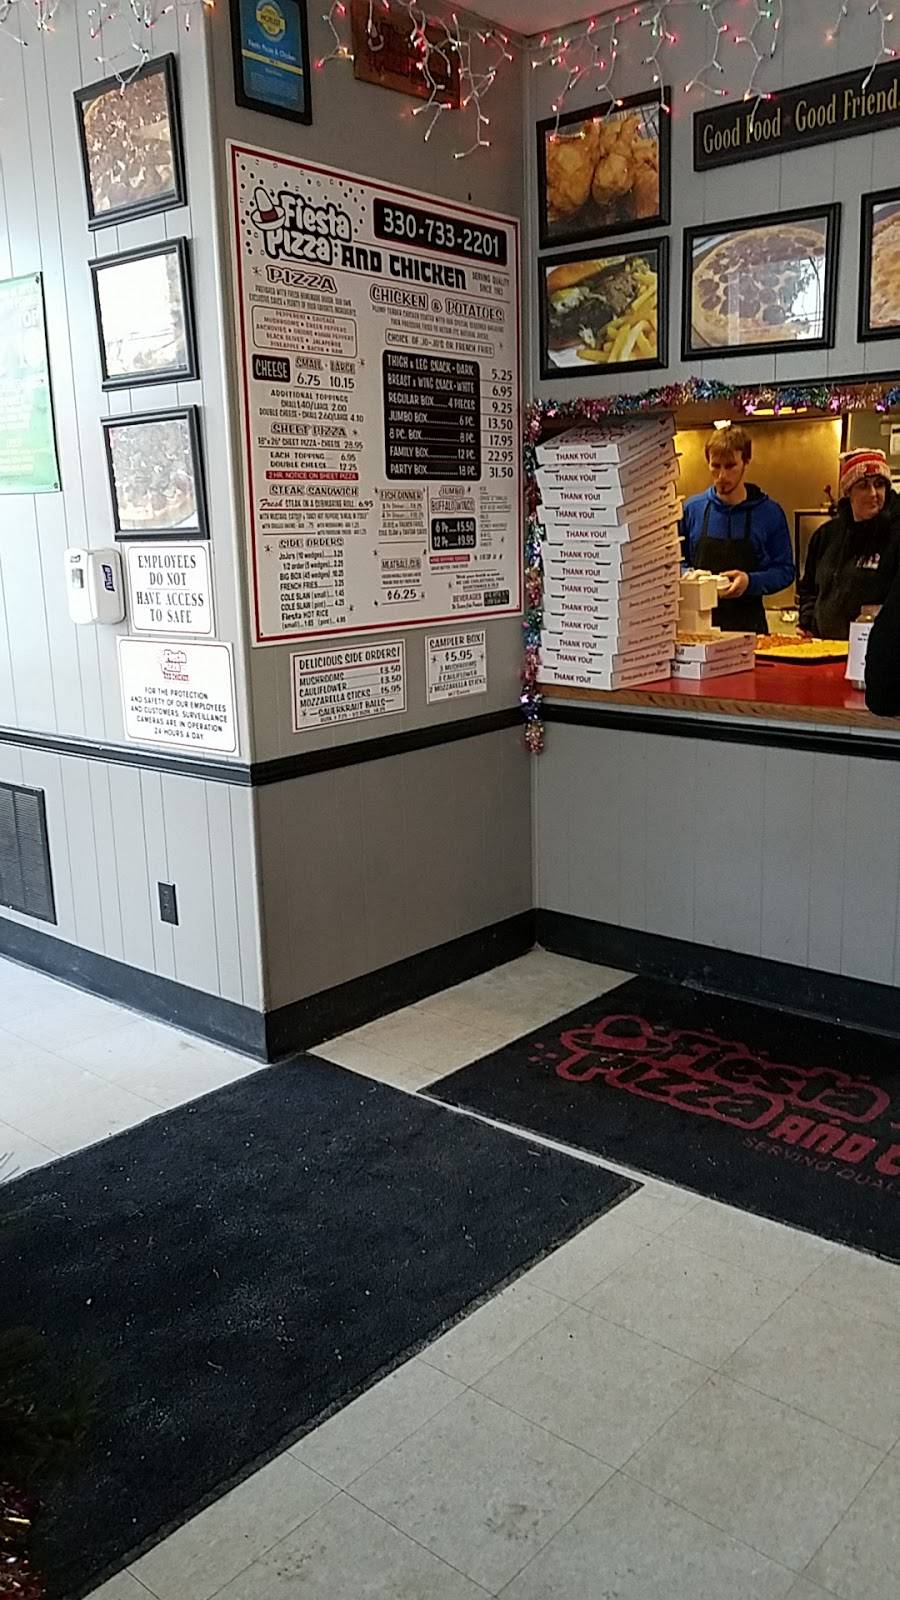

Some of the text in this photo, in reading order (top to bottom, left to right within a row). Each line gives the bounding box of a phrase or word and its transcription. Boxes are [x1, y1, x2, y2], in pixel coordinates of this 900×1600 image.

[703, 78, 900, 154] Good Food Good Friend
[278, 191, 352, 242] Fiesta
[384, 208, 499, 258] 330-733-2201
[264, 229, 466, 290] Pizza AND CHICKEN
[268, 266, 336, 293] PIZZA
[371, 285, 427, 309] CHICKEN
[447, 299, 504, 322] POTATOES
[388, 333, 492, 354] CHOICE FRENCH FRIES
[256, 359, 288, 378] CHEESE
[295, 357, 355, 374] SMALL LARGE
[387, 355, 512, 381] THIGH LEG SNACK DARK 5.25
[297, 372, 354, 388] 6.75 10.15
[388, 373, 512, 397] BREAST WING SNACK WHITE 6.95
[271, 389, 348, 402] ADDITIONAL TOPPINGS
[389, 392, 512, 414] REGULAR BOX PIECES 9.25
[389, 411, 513, 430] JUMBO BOX 13.50
[272, 423, 346, 437] SHEET PIZZA
[389, 428, 513, 446] 8 BOX 17.95
[390, 446, 513, 462] FAMILY BOX 12 22.95
[391, 464, 513, 478] PARTY BOX 31.50
[271, 485, 357, 496] STEAK SANDWICH
[441, 486, 464, 495] JUMBO
[259, 499, 283, 508] Fresh
[432, 498, 455, 513] BUFFALO
[436, 521, 440, 533] 6
[457, 521, 474, 532] $5.50
[279, 538, 343, 548] SIDE ORDERS
[434, 535, 474, 547] 12 $9.95
[138, 555, 196, 568] EMPLOYEES
[150, 572, 186, 585] DO NOT
[562, 568, 584, 576] THANK
[387, 589, 416, 601] $6.25
[562, 585, 598, 594] THANK YOU!
[137, 592, 203, 606] HAVE ACCESS
[281, 593, 295, 601] COLE
[453, 593, 482, 602] BEVERAGES
[281, 603, 295, 611] COLE
[150, 609, 192, 623] TO SAFE
[561, 621, 598, 630] THANK YOU!
[430, 633, 484, 649] SAMPLER BOX!
[560, 640, 596, 649] THANK YOU!
[299, 647, 400, 670] DELICIOUS SIDE ORDERS!
[445, 650, 472, 662] $5.95
[556, 654, 592, 664] THANK YOU!
[300, 664, 401, 686] MUSHROOMS $3.50
[554, 672, 591, 683] THANK YOU!
[299, 675, 401, 697] CAULIFLOWER $3.50
[435, 681, 467, 692] MOZZARELLA
[158, 688, 168, 696] THE
[171, 689, 208, 699] PROTECTION
[300, 685, 401, 708] MOZZARELLA STICKS $5.95
[176, 700, 188, 708] OUR
[190, 702, 226, 712] EMPLOYEES
[137, 715, 164, 725] CAMERAS
[187, 722, 222, 732] OPERATION
[183, 711, 227, 723] SURVEILLANCE
[164, 729, 184, 737] HOURS
[667, 1029, 890, 1123] Fiesta
[556, 1052, 784, 1129] Pizza
[768, 1114, 879, 1165] AND
[743, 1136, 900, 1196] SERVING QUAL
